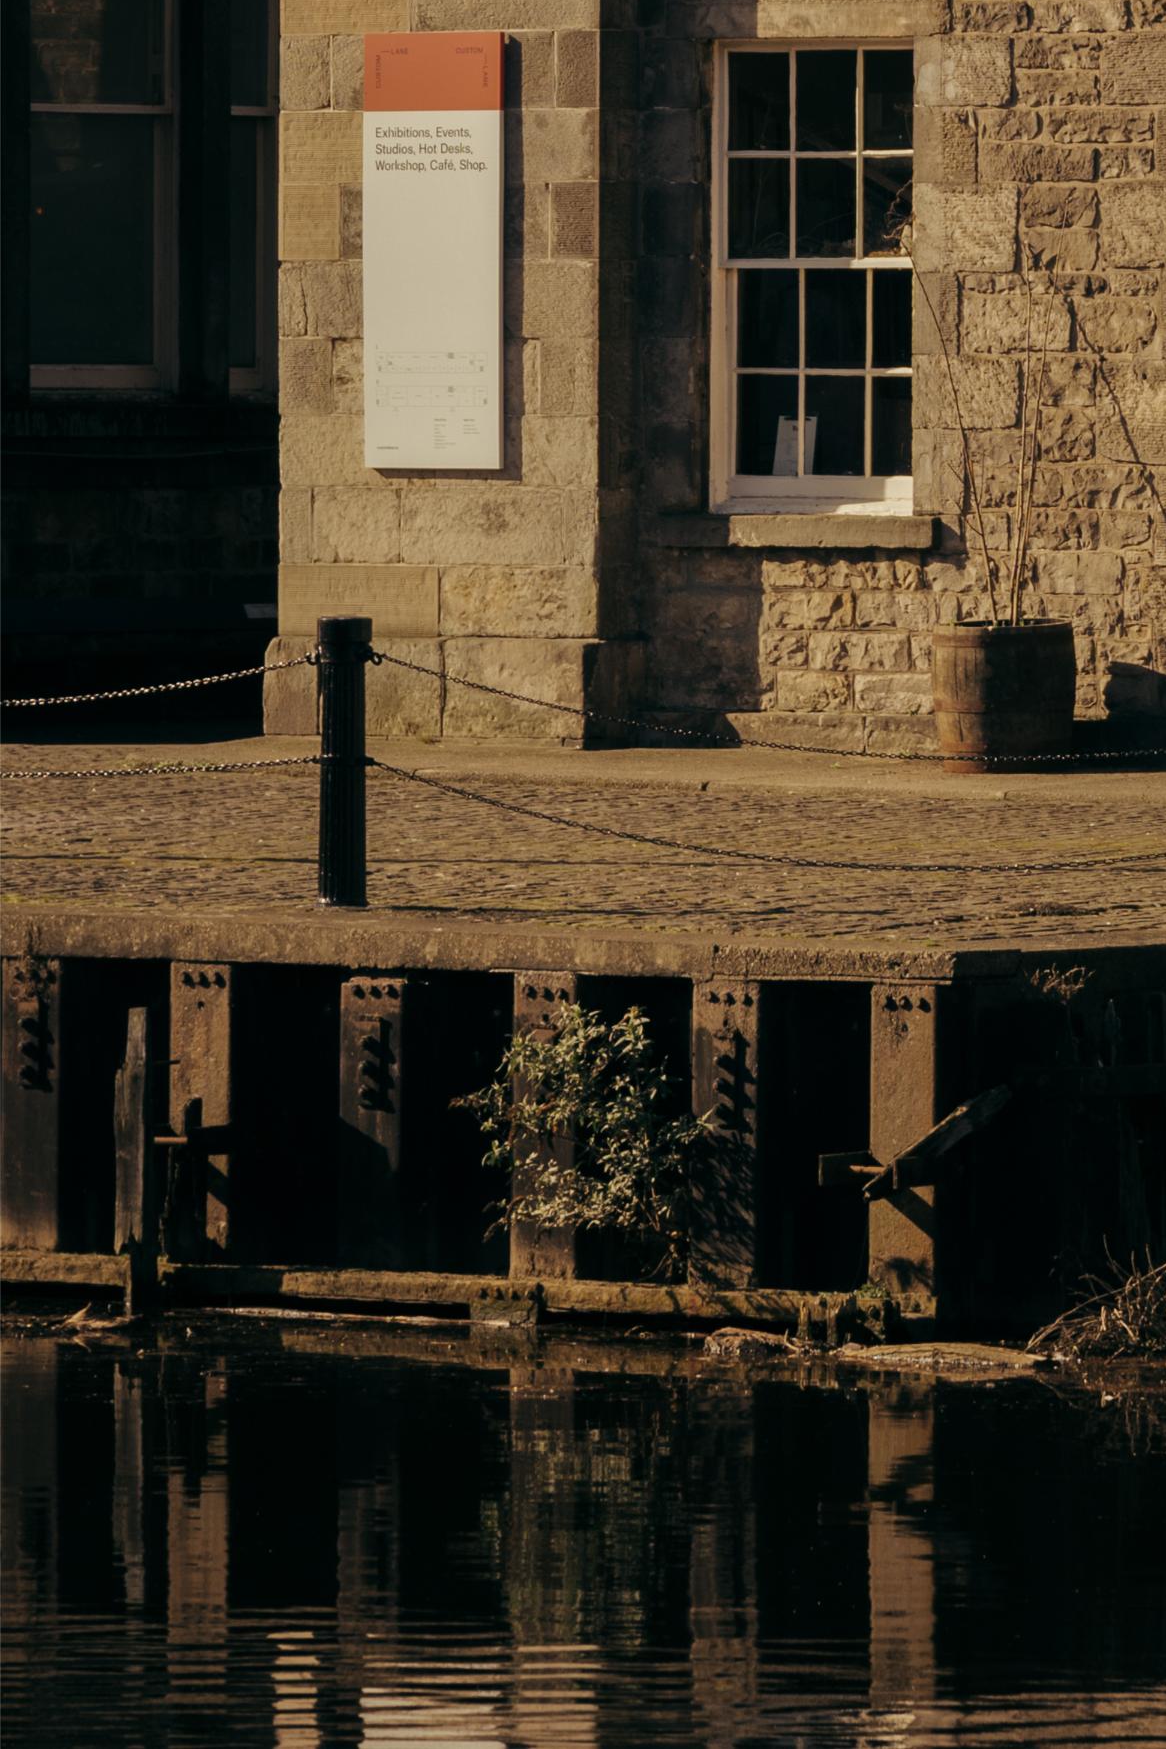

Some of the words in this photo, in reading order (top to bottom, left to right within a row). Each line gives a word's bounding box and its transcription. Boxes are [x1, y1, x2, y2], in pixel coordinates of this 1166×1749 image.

[375, 127, 433, 139] Exhibitions,
[436, 126, 472, 139] Events,
[375, 143, 416, 156] Studios,
[419, 143, 437, 154] Hot
[440, 142, 473, 155] Desks,
[375, 159, 427, 173] Workshop,
[429, 158, 456, 172] Café,
[459, 158, 488, 173] Shop.
